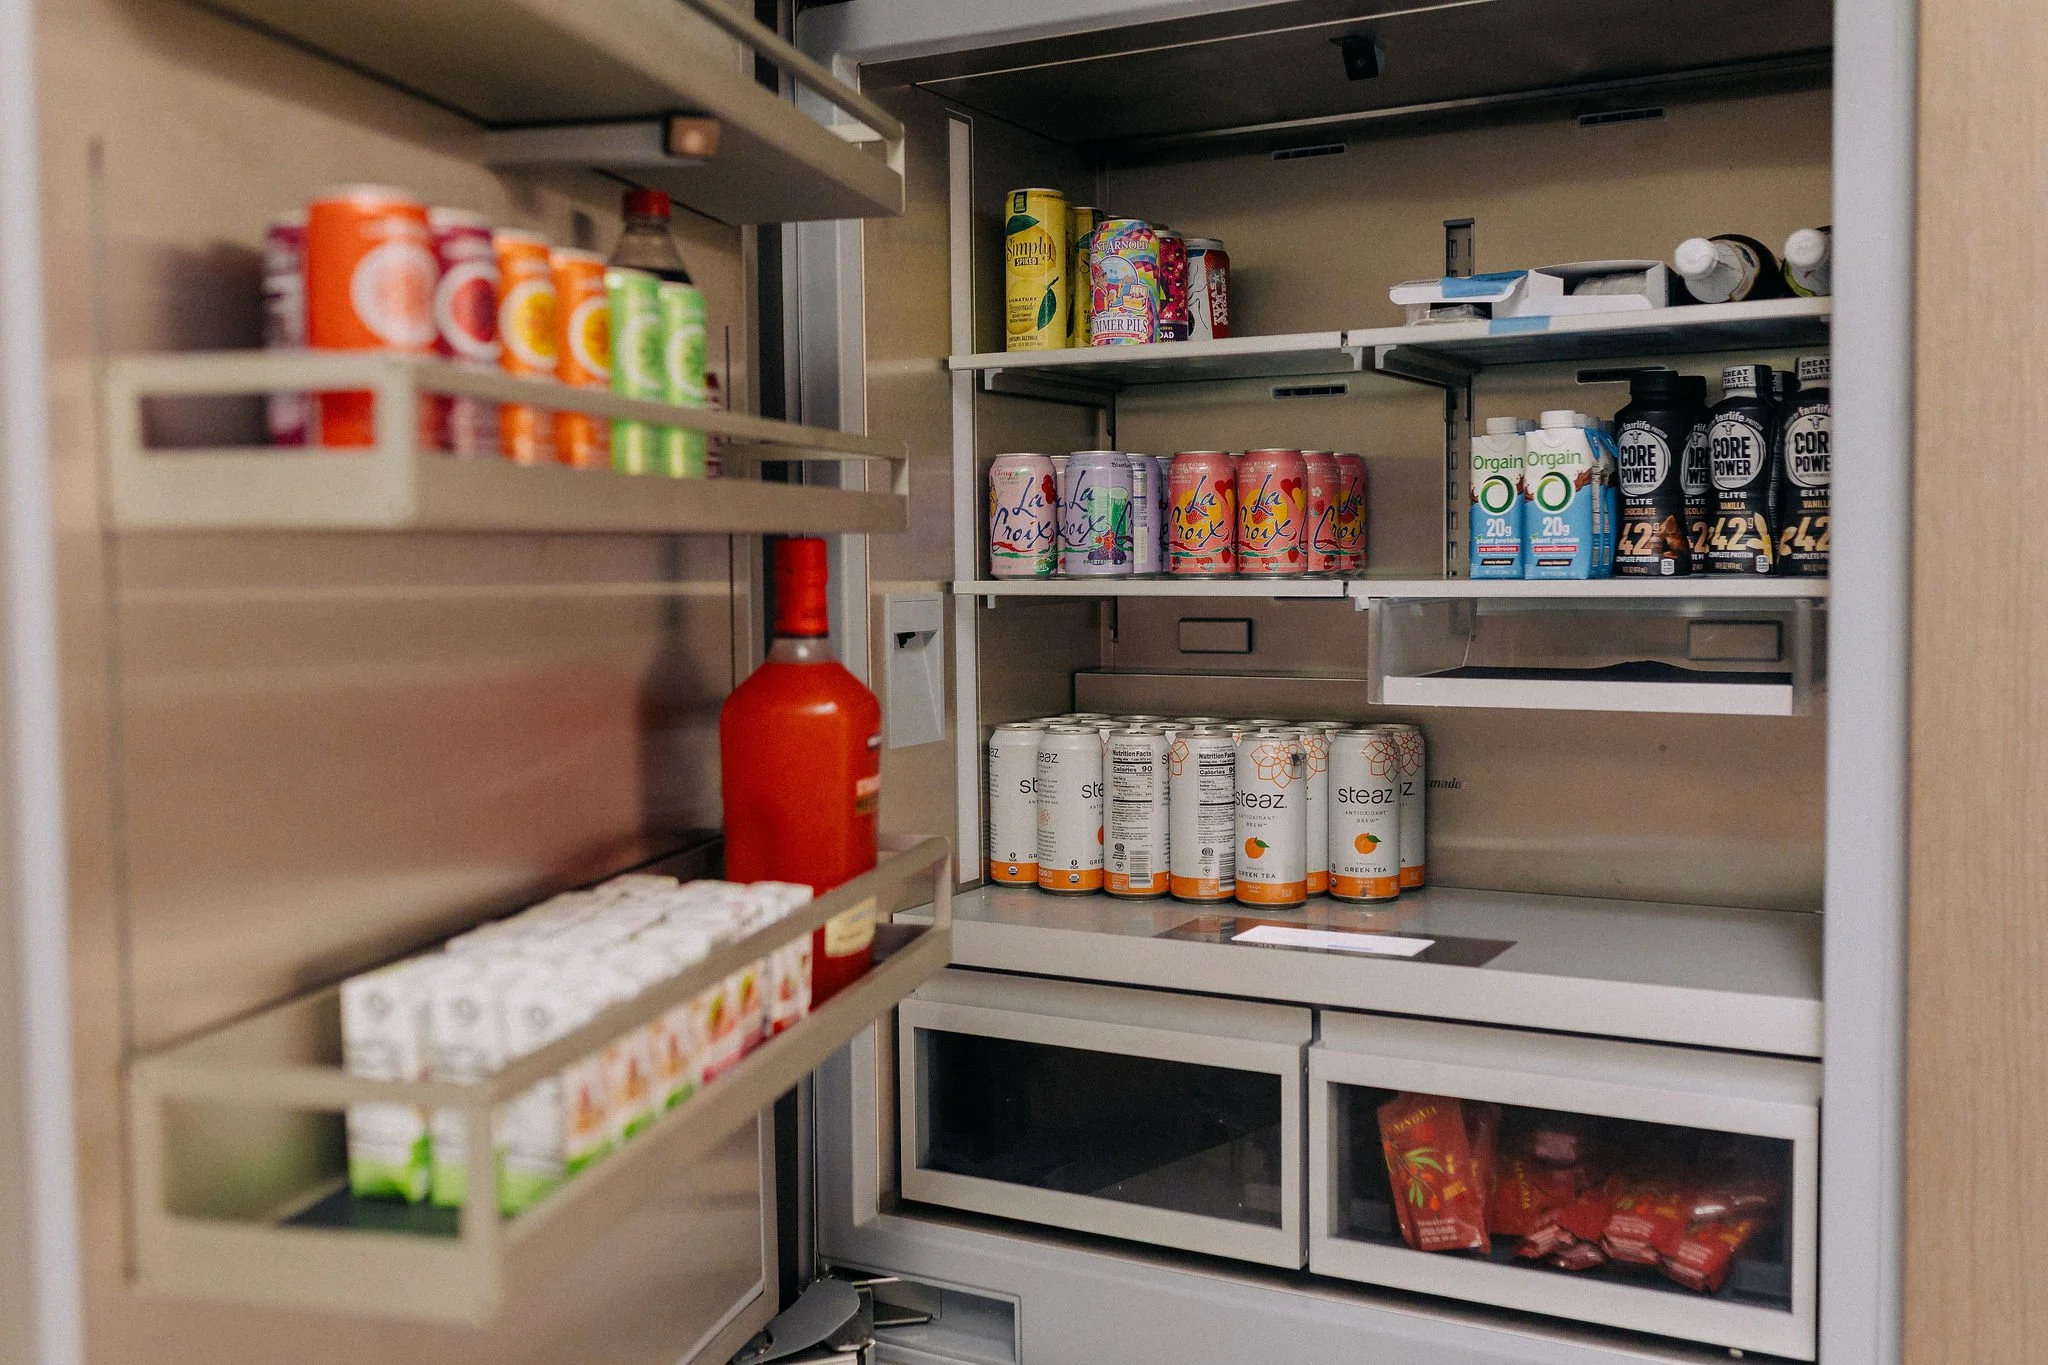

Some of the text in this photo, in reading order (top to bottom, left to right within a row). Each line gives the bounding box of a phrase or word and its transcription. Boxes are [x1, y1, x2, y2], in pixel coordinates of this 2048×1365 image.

[1007, 236, 1055, 262] Simply
[1106, 240, 1148, 254] ARNOLD
[1015, 257, 1038, 266] SPIKED
[1127, 318, 1148, 334] PILS
[1160, 331, 1175, 339] OAD
[1724, 370, 1748, 379] GREAT
[1724, 378, 1749, 387] TASTE
[1715, 410, 1745, 422] fairlife
[1622, 421, 1651, 432] fairlife
[1712, 437, 1751, 459] CORE
[1794, 431, 1830, 455] COR
[1473, 454, 1525, 473] Orgain
[1527, 449, 1582, 469] Orgain
[1620, 445, 1656, 467] CORE
[1795, 455, 1830, 472] POWE
[1621, 467, 1656, 484] POWER
[1714, 459, 1751, 476] POWER
[1013, 477, 1044, 519] La
[1069, 470, 1096, 513] La
[1186, 474, 1217, 518] La
[1251, 473, 1282, 517] La
[1718, 490, 1748, 499] ELITE
[1625, 498, 1653, 506] ELITE
[1719, 500, 1746, 509] VANILLA
[1624, 507, 1656, 515] CHOCOLATE
[992, 507, 1057, 554] Croix
[1170, 505, 1228, 548] Croix
[1240, 505, 1296, 548] Croix
[1486, 517, 1512, 538] 20g
[1543, 517, 1571, 538] 20g
[1238, 870, 1258, 878] GREEN
